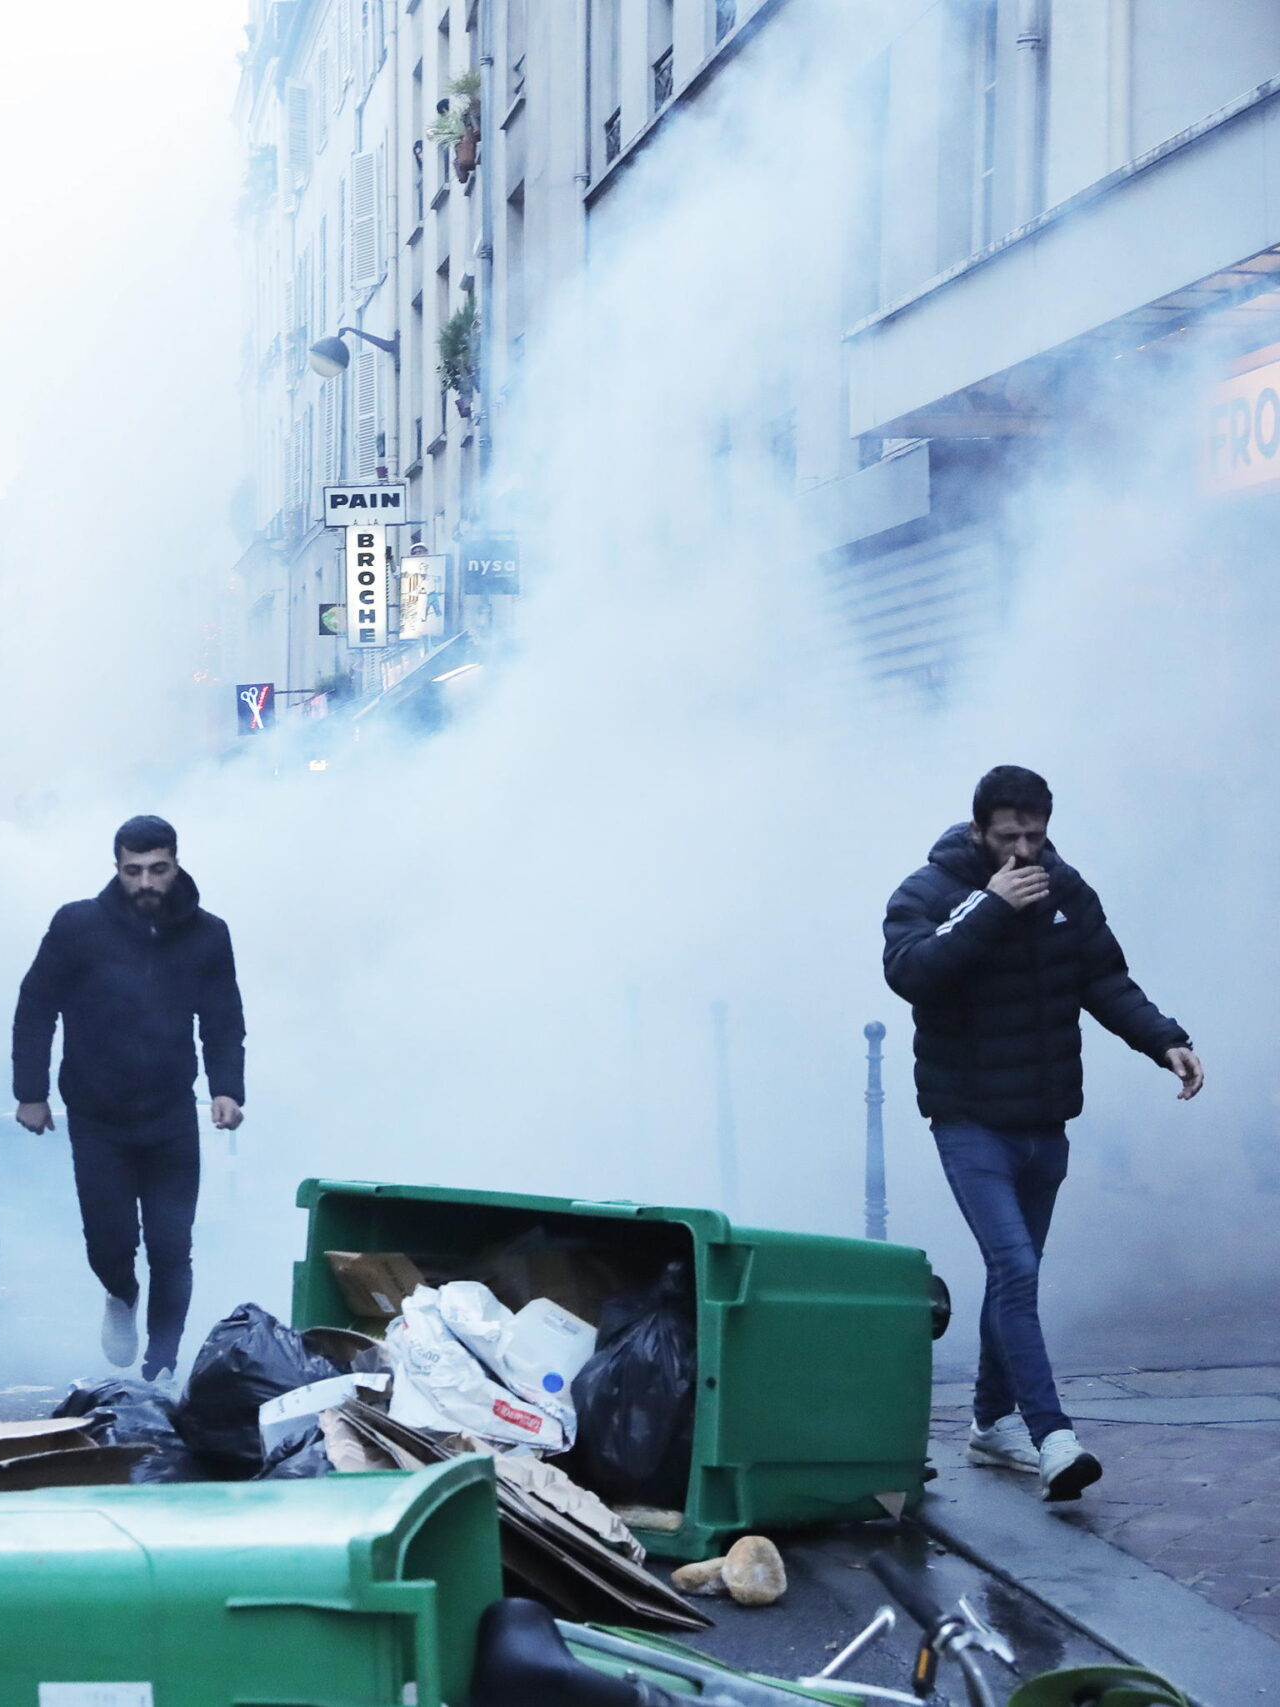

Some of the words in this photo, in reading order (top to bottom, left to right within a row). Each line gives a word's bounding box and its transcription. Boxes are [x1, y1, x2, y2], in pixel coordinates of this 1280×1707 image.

[330, 492, 401, 509] PAIN
[467, 558, 516, 576] nysa
[356, 533, 376, 643] BROCHE
